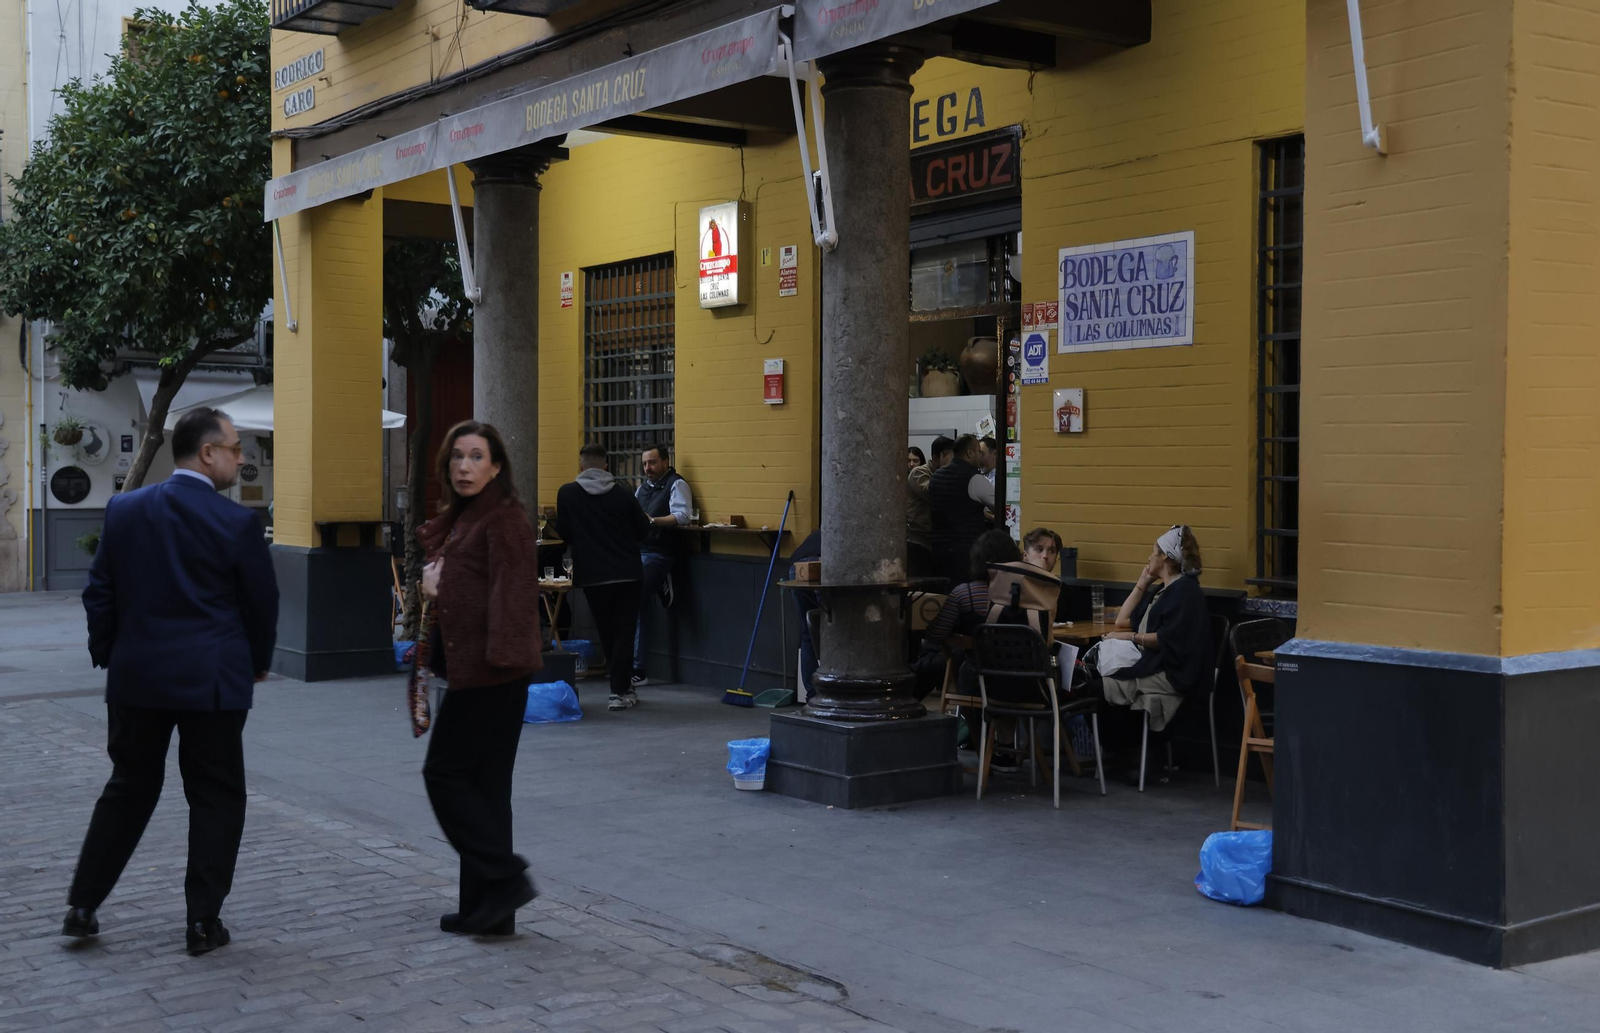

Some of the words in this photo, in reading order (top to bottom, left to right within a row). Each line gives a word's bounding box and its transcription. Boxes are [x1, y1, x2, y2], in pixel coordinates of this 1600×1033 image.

[275, 49, 323, 90] RODRIGO
[701, 35, 755, 65] Cruzcampo
[284, 88, 313, 116] CARO
[526, 92, 568, 132] BODEGA
[571, 82, 608, 118] SANTA
[613, 68, 646, 105] CRUZ
[926, 143, 1012, 197] CRUZ
[1060, 251, 1149, 290] BODEGA
[1066, 287, 1122, 322] SANTA
[1126, 281, 1185, 316] CRUZ
[1077, 323, 1100, 342] LAS
[1105, 316, 1172, 340] COLUMNAS
[1027, 344, 1043, 357] ADT
